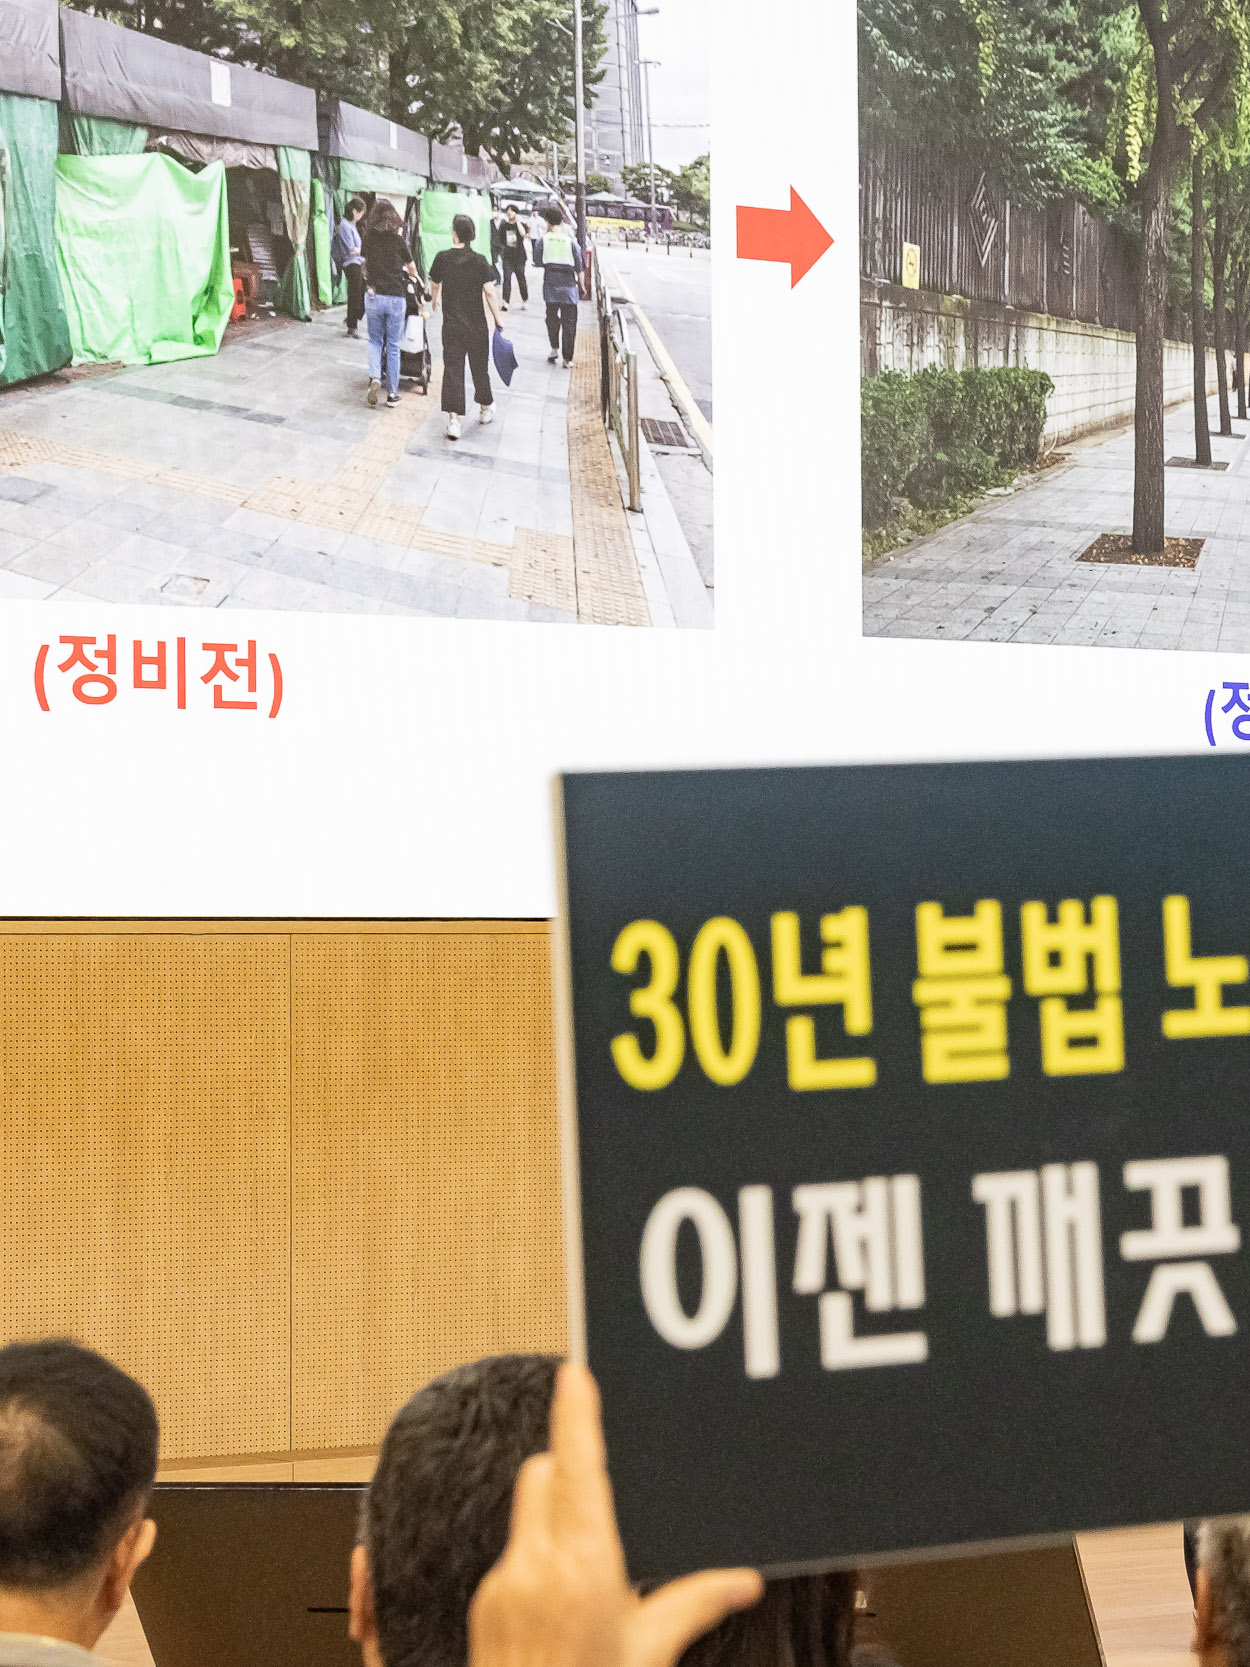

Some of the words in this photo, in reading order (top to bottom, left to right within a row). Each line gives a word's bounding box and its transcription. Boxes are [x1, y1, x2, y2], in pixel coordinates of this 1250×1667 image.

[34, 634, 283, 718] (정비전)
[610, 905, 877, 1091] 30년
[912, 895, 1126, 1084] 불법
[639, 1173, 928, 1379] 이젠
